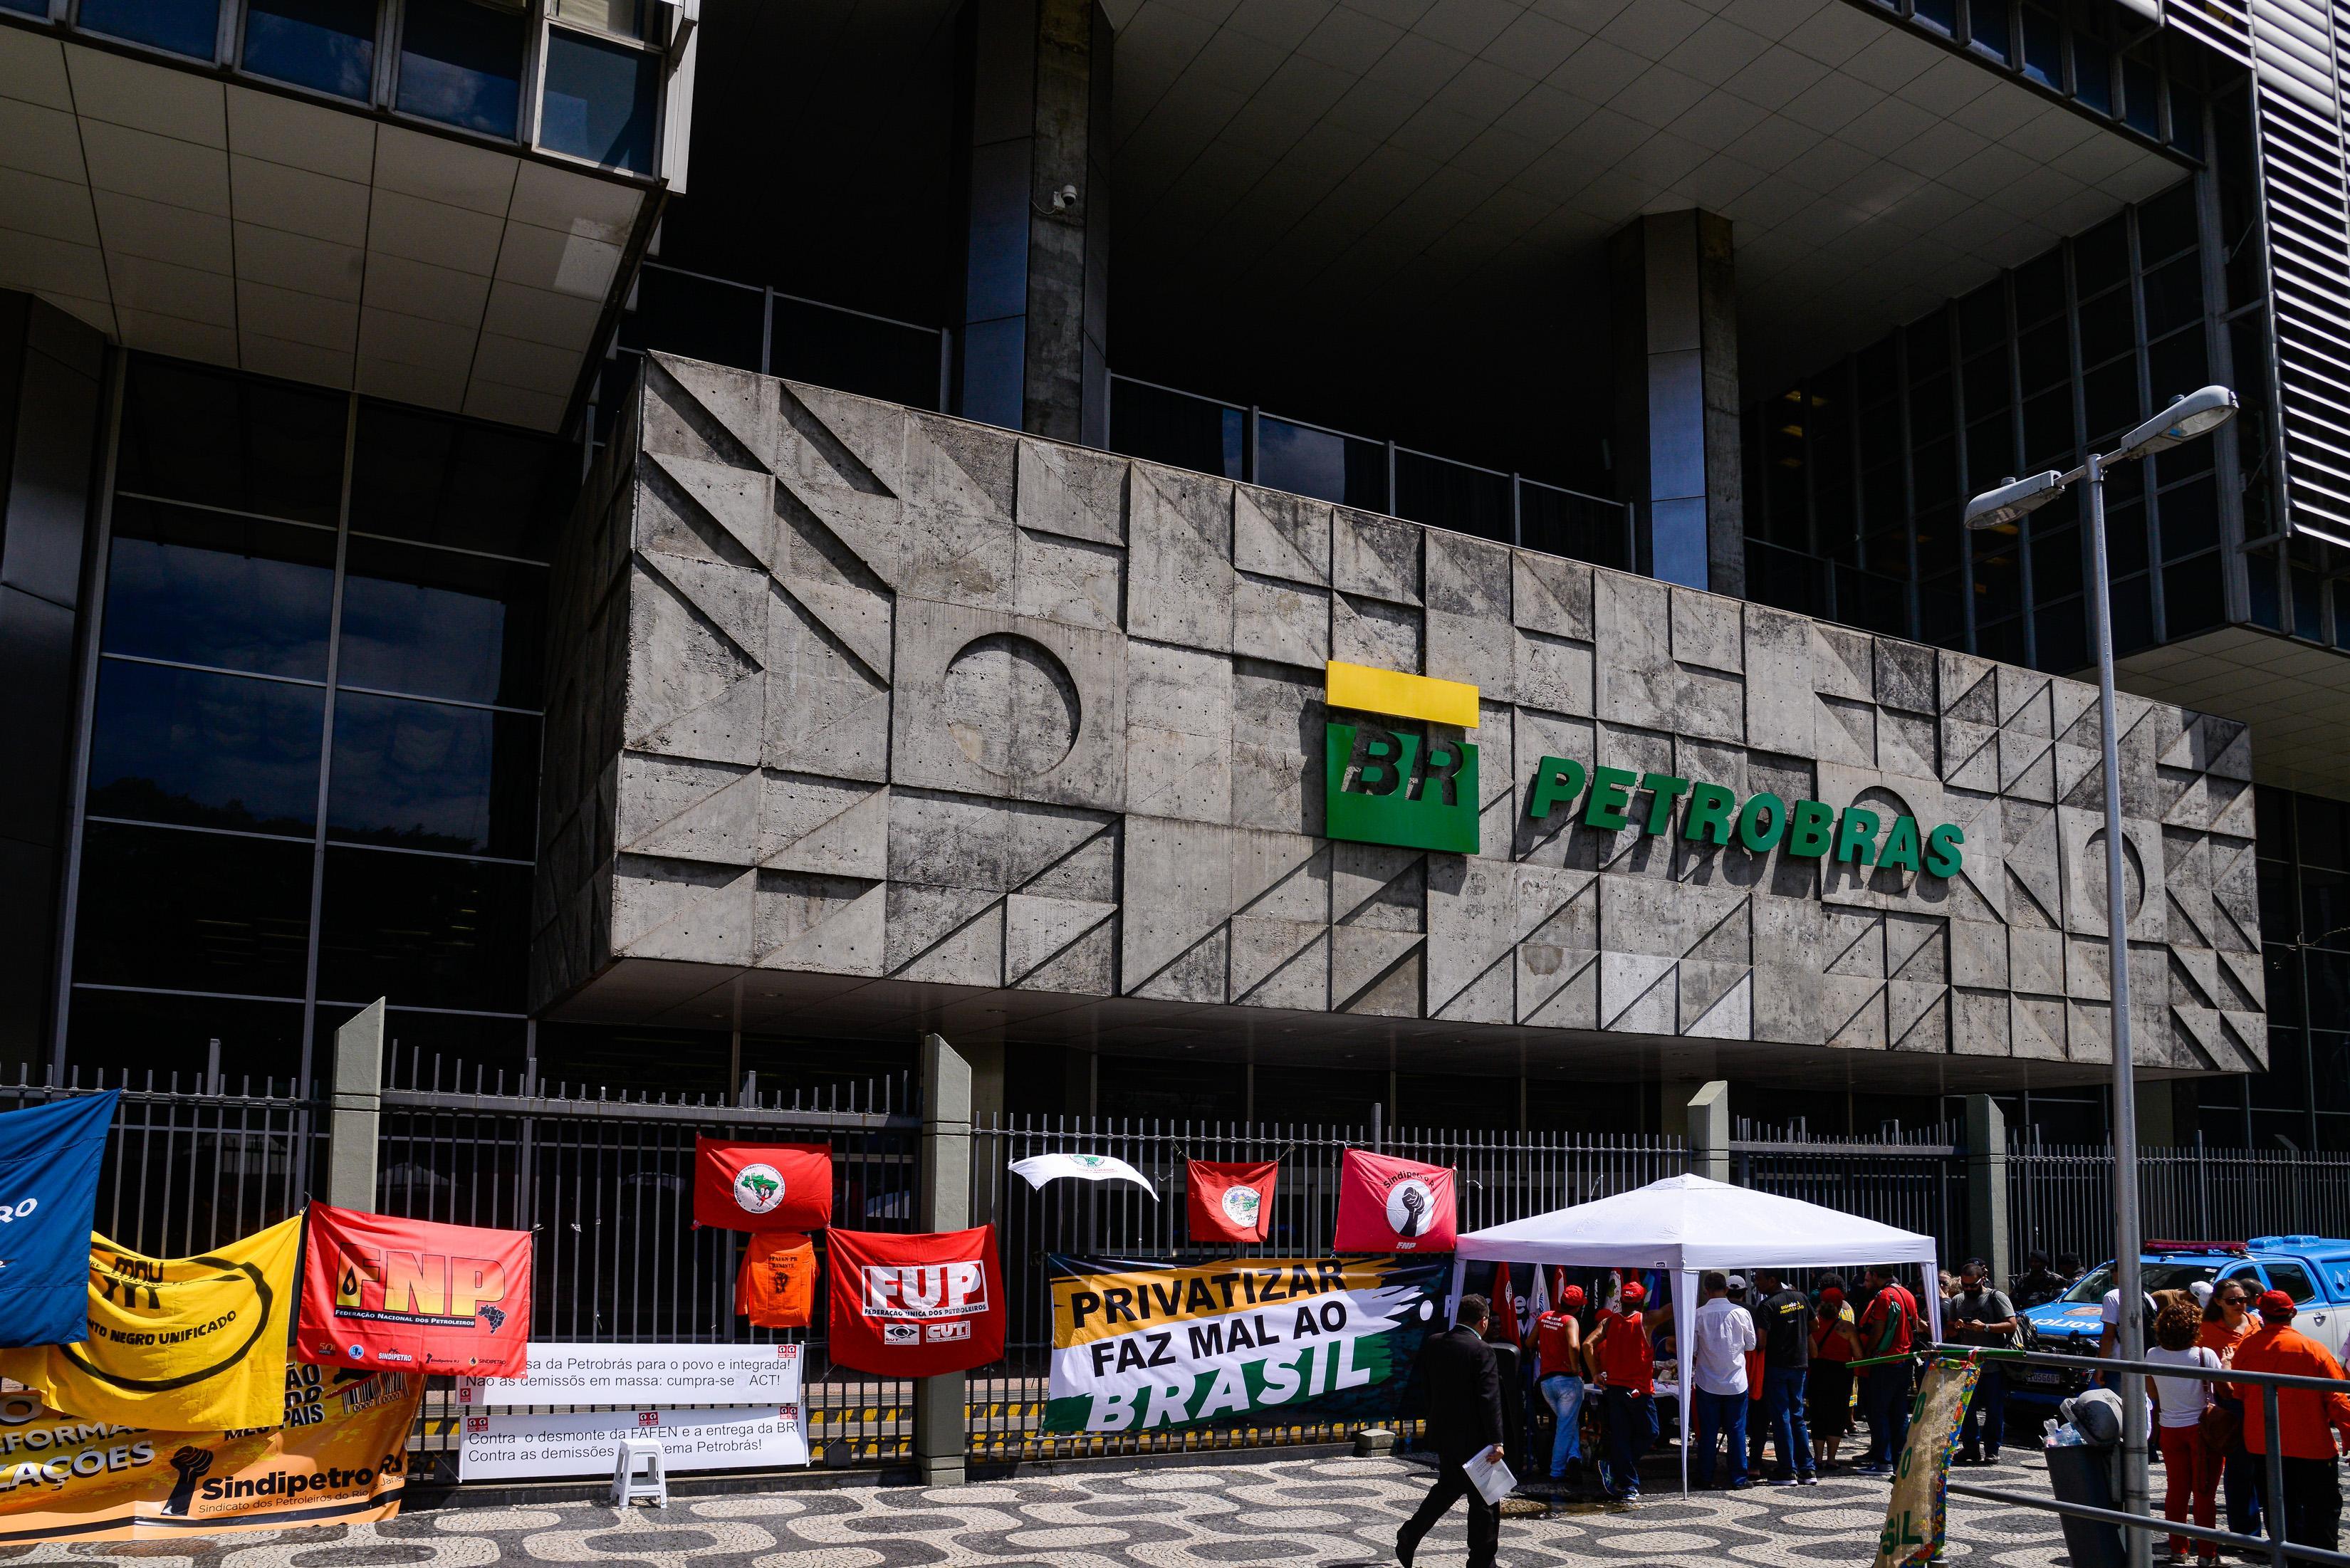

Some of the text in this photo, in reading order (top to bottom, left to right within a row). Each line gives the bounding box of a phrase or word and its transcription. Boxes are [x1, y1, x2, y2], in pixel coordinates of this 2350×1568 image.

[1340, 728, 1463, 806] BR
[1530, 756, 1964, 878] PETROBRAS
[1396, 1241, 1416, 1250] FNP
[335, 1242, 506, 1317] FNP
[870, 1264, 981, 1310] FUP
[1071, 1260, 1348, 1328] PRIVATIZAR
[335, 1309, 375, 1319] FEDERAÇÃO
[377, 1312, 414, 1322] NACIONAL
[430, 1317, 475, 1327] PETROLEIROS
[865, 1304, 987, 1317] FEDERAÇÃO ÚNICA DOS PETROLEIROS
[110, 1329, 156, 1346] NEGRO
[159, 1310, 237, 1345] UNIFICADO
[1091, 1300, 1347, 1378] FAZ MAL AO
[378, 1352, 412, 1362] SINDIPETRO
[545, 1358, 563, 1370] da
[568, 1357, 632, 1370] Petrobrás
[637, 1360, 667, 1371] para
[670, 1361, 679, 1370] o
[683, 1361, 714, 1372] povo
[718, 1361, 726, 1370] e
[730, 1359, 791, 1373] integrada!
[521, 1374, 585, 1386] demissõs
[590, 1377, 615, 1386] em
[615, 1377, 662, 1386] massa:
[667, 1376, 735, 1389] cumpra-se
[749, 1374, 780, 1386] ACT!
[1085, 1334, 1371, 1431] BRASIL
[0, 1421, 135, 1455] FORMA
[469, 1421, 800, 1445] Contra o desmonte da FAFEN e a entrega da BR!
[469, 1449, 516, 1463] Contra
[520, 1451, 537, 1460] as
[541, 1446, 615, 1460] demissões
[696, 1438, 762, 1453] Petrobrás!
[199, 1501, 250, 1514] Sindicato
[253, 1500, 273, 1509] dos
[276, 1493, 332, 1507] Petroleiros
[335, 1490, 349, 1500] do
[352, 1488, 370, 1498] Rio
[200, 1467, 374, 1501] Sindipetro
